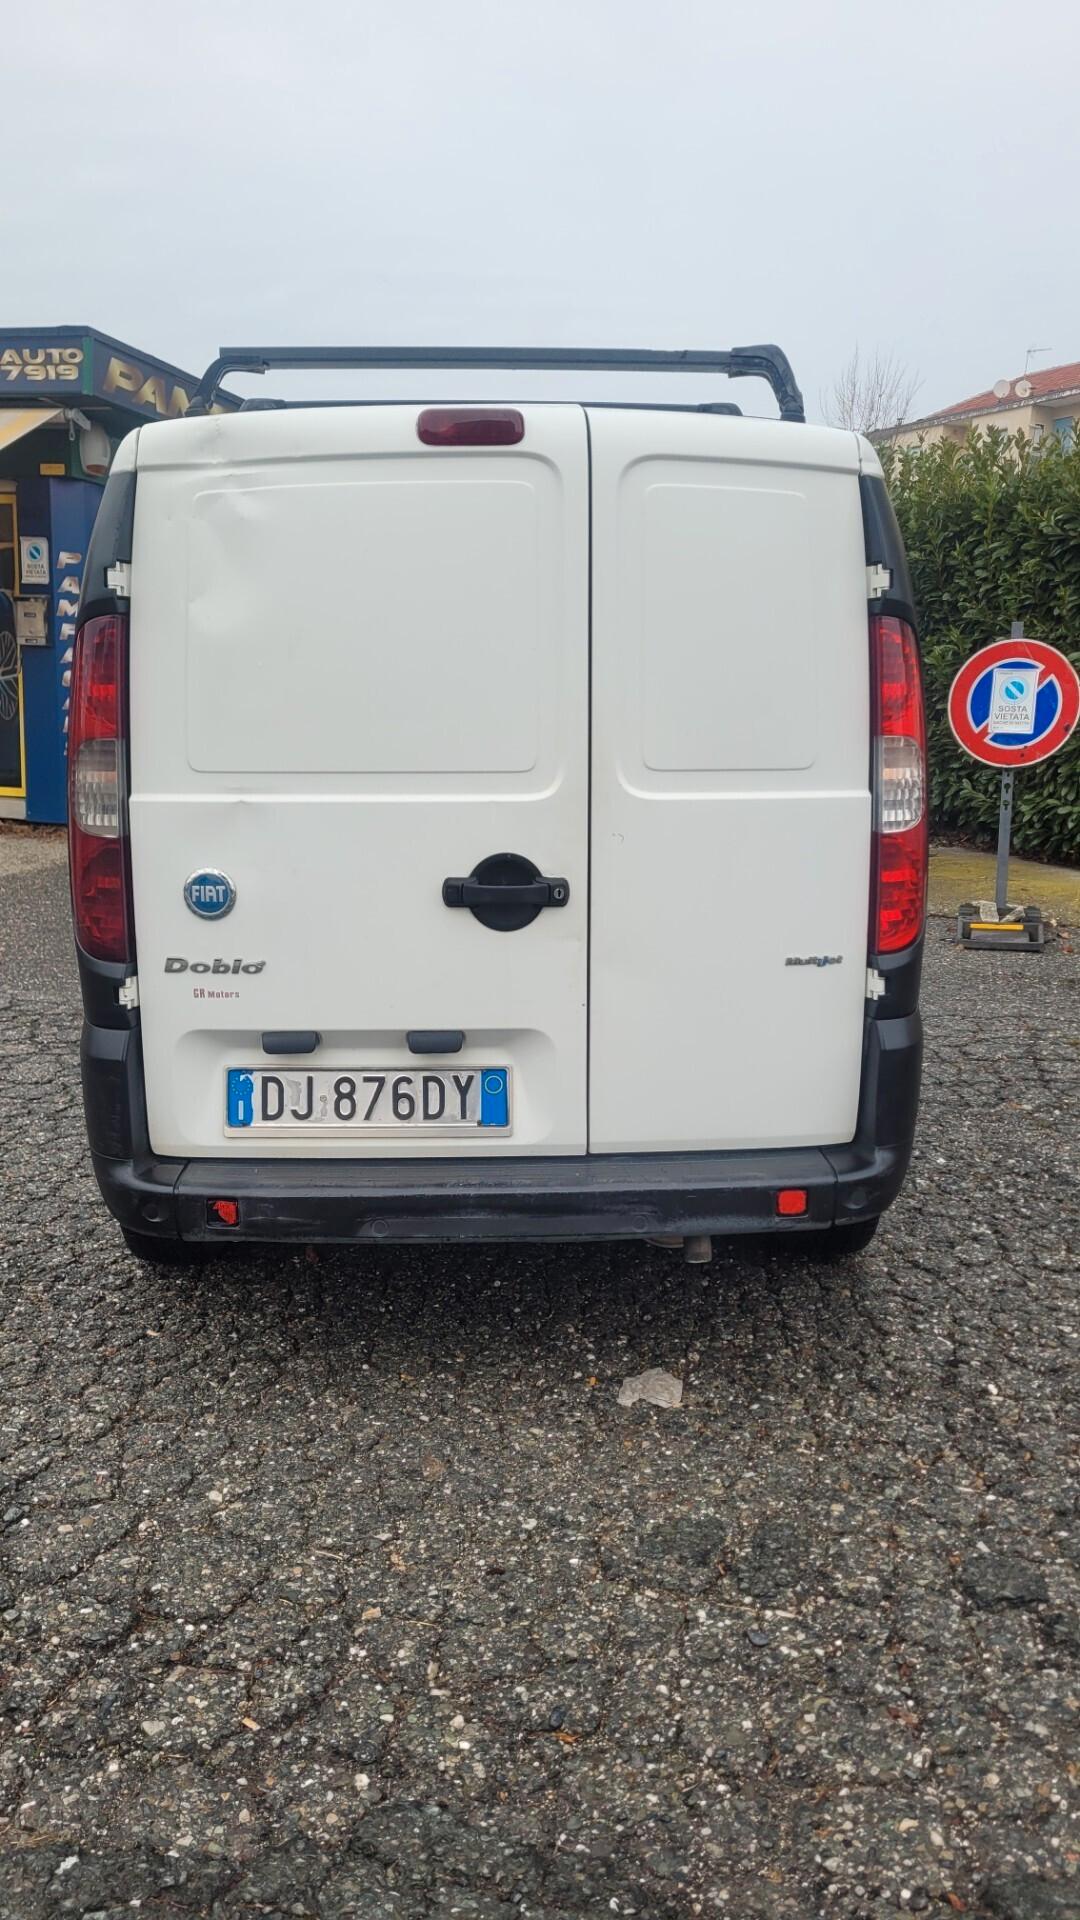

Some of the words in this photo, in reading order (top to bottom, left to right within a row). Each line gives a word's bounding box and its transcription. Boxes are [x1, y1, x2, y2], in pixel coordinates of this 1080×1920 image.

[0, 348, 84, 364] AUTO
[1, 365, 79, 381] 7919
[998, 705, 1028, 713] SOSTA
[994, 712, 1031, 720] VIETATA
[191, 885, 226, 902] FIAT
[207, 990, 240, 998] Motors
